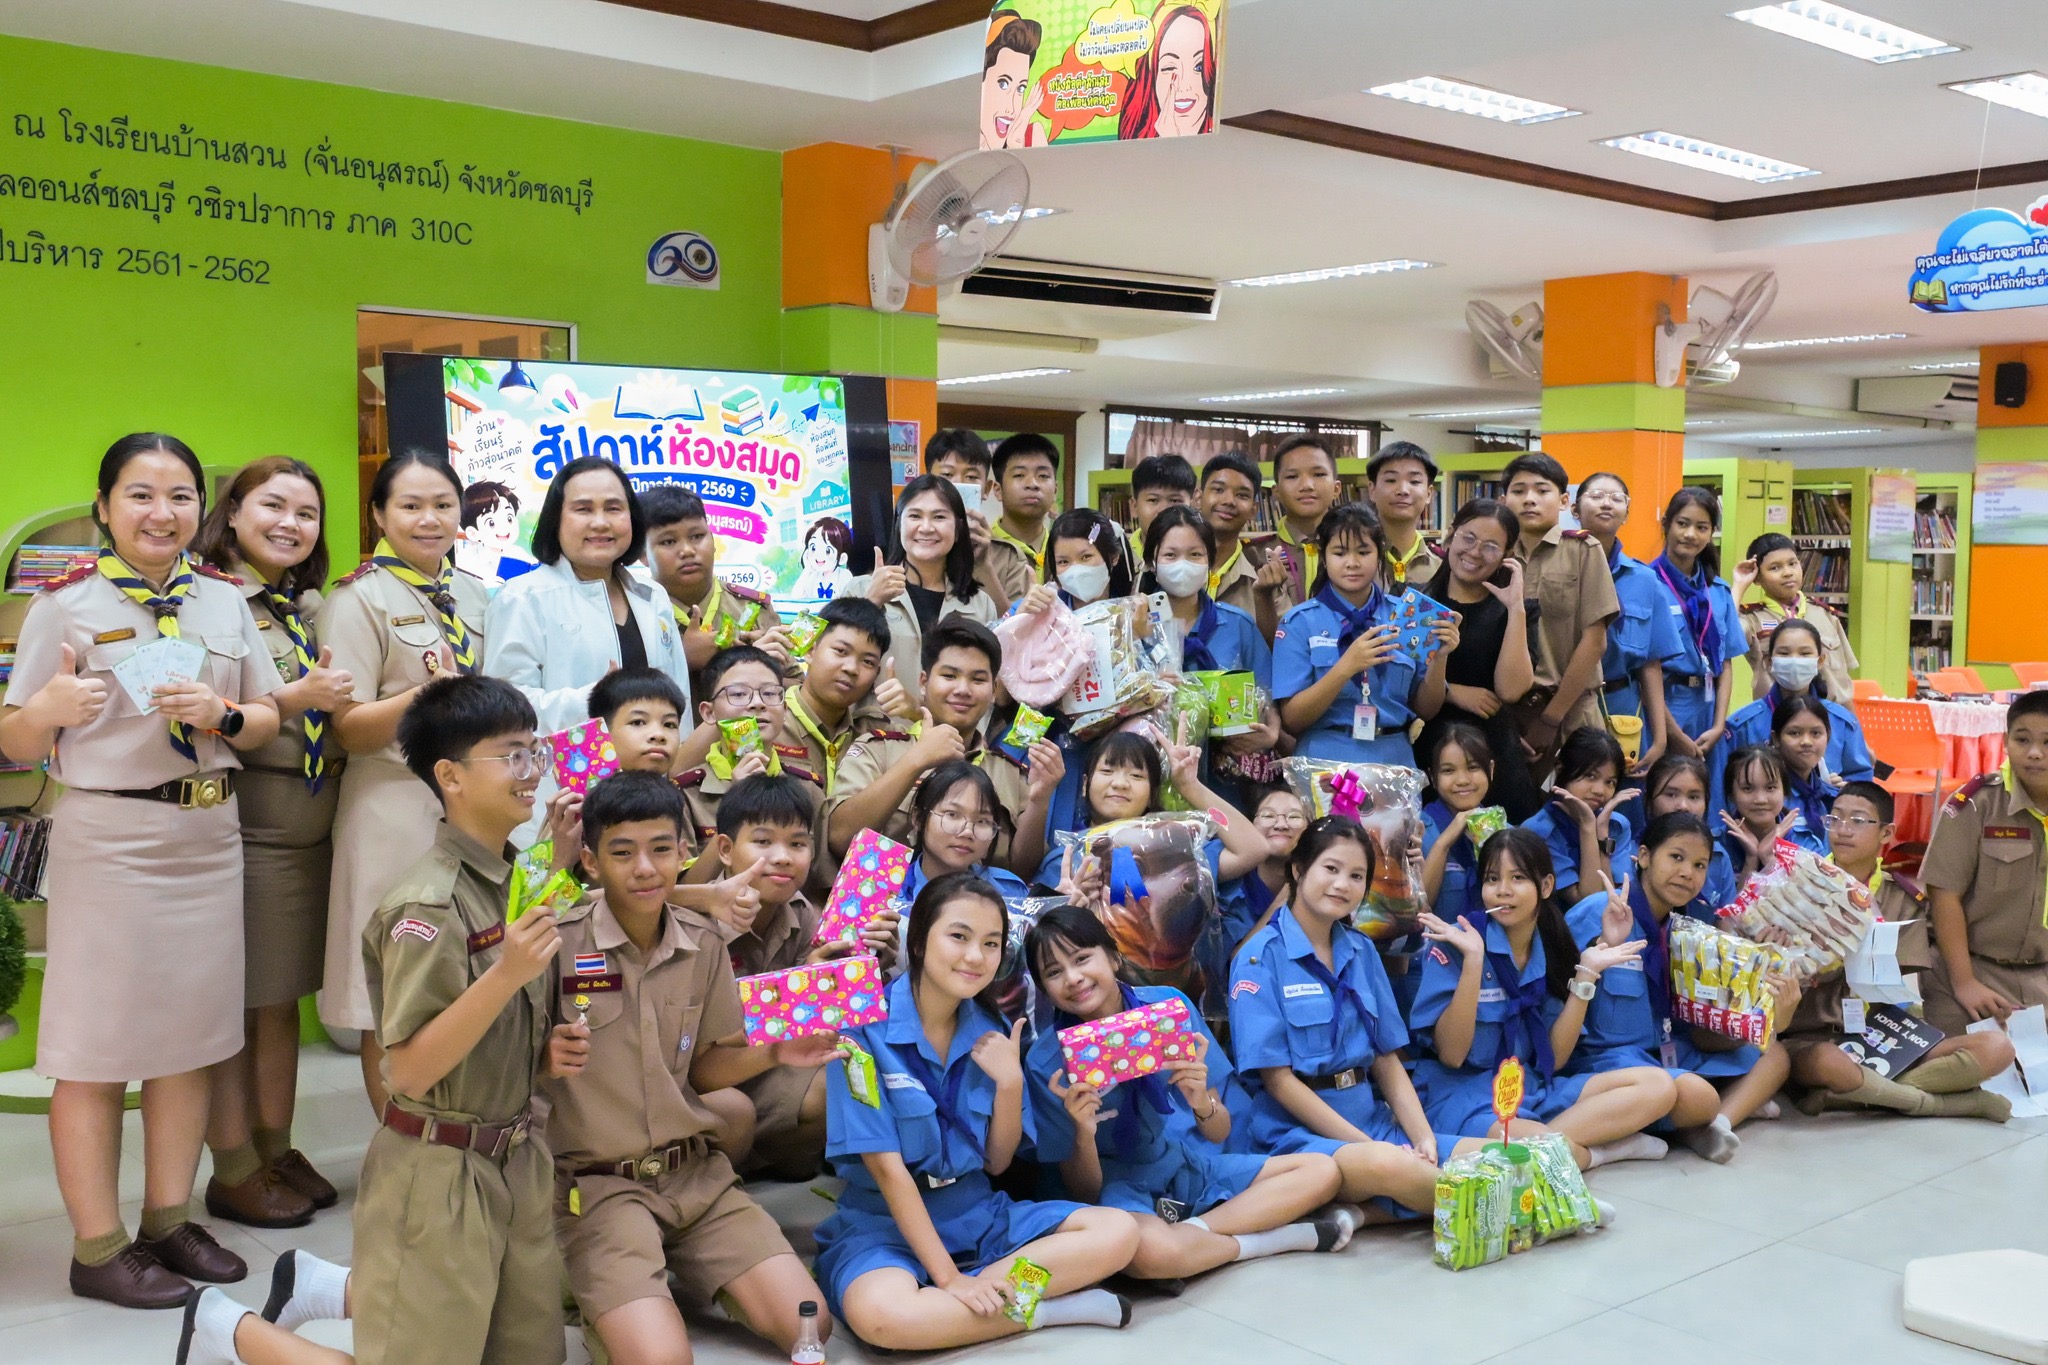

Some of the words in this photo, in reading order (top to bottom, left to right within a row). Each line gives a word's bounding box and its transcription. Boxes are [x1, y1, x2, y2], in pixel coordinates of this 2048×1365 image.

[13, 113, 46, 139] ณ
[59, 108, 287, 169] โรงเรียนบ้านสวน
[304, 136, 450, 193] (จั่นอนุสรณ์)
[458, 169, 594, 216] จังหวัดชลบุรี
[187, 187, 335, 232] วชิรปราการ
[347, 216, 397, 239] ภาค
[411, 218, 473, 246] 310C
[0, 229, 104, 270] บริหาร
[476, 421, 496, 435] อ่าน
[810, 427, 835, 443] ห้องสมุด
[475, 431, 503, 452] เรียนรู้
[816, 437, 837, 454] คือพื้นที่
[817, 449, 844, 465] ของทุกคน
[701, 480, 736, 499] 2569
[809, 494, 845, 511] LIBRARY
[731, 572, 755, 584] 2569
[1084, 680, 1100, 703] 12
[1874, 1013, 1902, 1033] TOUCH
[1901, 1017, 1918, 1030] ME
[1498, 1074, 1519, 1091] Chupa
[1497, 1087, 1518, 1104] Chups
